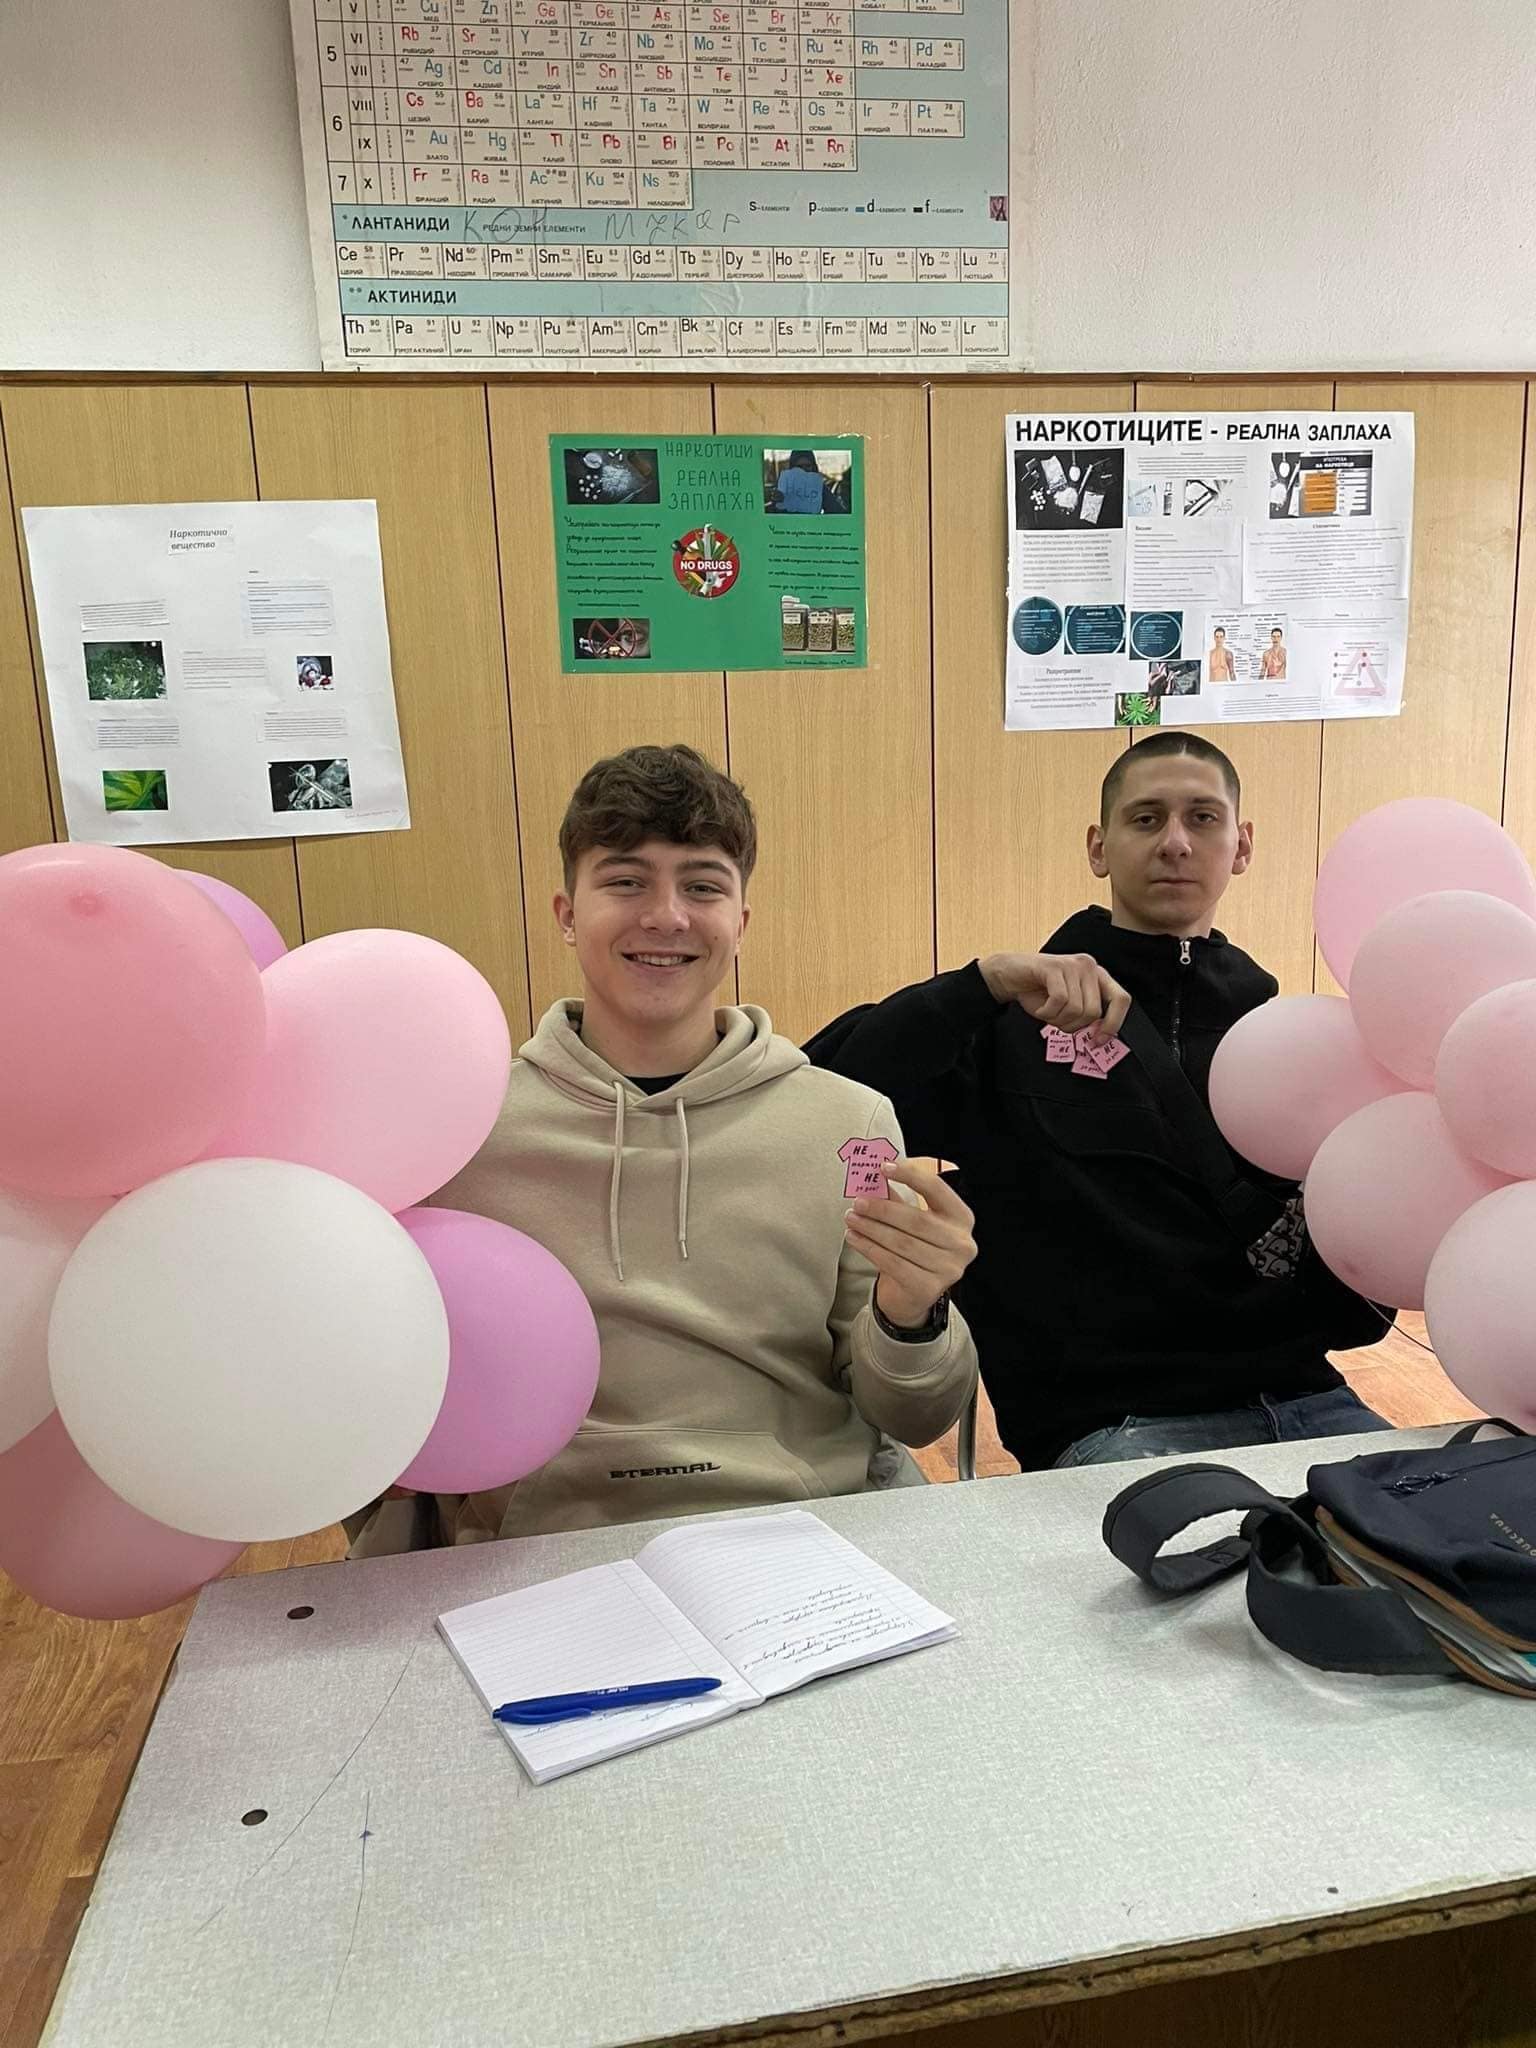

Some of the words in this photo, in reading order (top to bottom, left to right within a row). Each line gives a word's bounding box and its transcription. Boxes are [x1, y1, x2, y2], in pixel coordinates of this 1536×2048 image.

[350, 3, 357, 13] V
[482, 0, 498, 15] Zn
[538, 3, 556, 17] Ga
[596, 4, 614, 18] Ge
[654, 7, 671, 21] As
[713, 8, 729, 23] Se
[771, 10, 784, 24] Br
[826, 12, 841, 27] Kr
[351, 33, 362, 44] VI
[402, 26, 419, 41] Rb
[462, 28, 476, 42] Sr
[521, 30, 529, 44] Y
[580, 32, 593, 46] Zr
[637, 34, 654, 48] Nb
[695, 36, 714, 50] Mo
[752, 37, 766, 52] Tc
[807, 40, 823, 53] Ru
[862, 41, 878, 55] Rh
[327, 46, 336, 61] 5
[916, 42, 932, 56] Pd
[351, 65, 367, 76] VII
[424, 59, 442, 78] Ag
[484, 58, 502, 74] Cd
[547, 62, 559, 77] In
[599, 63, 616, 78] Sn
[657, 65, 672, 79] Sb
[717, 67, 731, 82] Te
[781, 68, 788, 82] J
[826, 69, 843, 84] Xe
[352, 100, 372, 111] VIII
[407, 92, 424, 106] Cs
[466, 91, 483, 108] Ba
[583, 96, 597, 111] Hf
[640, 98, 656, 112] Ta
[697, 99, 710, 113] W
[753, 101, 769, 115] Re
[809, 102, 825, 116] Os
[864, 103, 872, 117] Ir
[917, 104, 931, 118] Pt
[333, 116, 342, 131] 6
[358, 138, 371, 149] IX
[429, 130, 447, 144] Au
[489, 131, 506, 151] Hg
[551, 133, 562, 147] Tl
[603, 133, 621, 149] Pb
[663, 135, 677, 150] Bi
[717, 137, 733, 151] Po
[775, 139, 789, 152] At
[827, 139, 844, 153] Rn
[413, 168, 427, 182] Fr
[471, 169, 488, 184] Ra
[586, 172, 604, 186] Ku
[643, 173, 659, 187] Ns
[338, 175, 346, 191] 7
[364, 178, 372, 189] X
[352, 217, 449, 232] ЛАНТАНИДИ
[339, 247, 357, 261] Ce
[389, 247, 404, 261] Pr
[446, 248, 463, 262] Nd
[491, 249, 512, 263] Pm
[539, 249, 560, 263] Sm
[587, 250, 602, 264] Eu
[633, 250, 650, 264] Gd
[680, 251, 695, 265] Tb
[725, 251, 743, 270] Dy
[776, 252, 792, 265] Ho
[823, 252, 835, 266] Er
[868, 253, 882, 266] Tu
[920, 253, 934, 266] Yb
[963, 252, 977, 266] Lu
[368, 290, 456, 304] АКТИНИДИ
[347, 320, 364, 334] Th
[396, 320, 413, 334] Pa
[452, 320, 461, 334] U
[497, 321, 514, 338] Np
[544, 321, 560, 335] Pu
[592, 322, 613, 335] Am
[637, 322, 657, 335] Cm
[681, 319, 698, 333] Bk
[728, 322, 743, 335] Cf
[778, 322, 793, 335] Es
[825, 322, 843, 335] Fm
[870, 322, 887, 335] Md
[920, 322, 936, 335] No
[964, 322, 976, 334] Lr
[1016, 419, 1202, 445] НАРКОТИЦИТЕ
[1227, 423, 1300, 442] РЕАЛНА
[1308, 423, 1392, 442] ЗАПЛАХА
[665, 441, 753, 458] НАРКОТИЦИ
[677, 469, 740, 486] РЕАЛНА
[668, 492, 754, 511] ЗАПЛАХА
[170, 530, 228, 539] Наркотично
[171, 542, 215, 550] вещество
[680, 561, 695, 570] NO
[697, 561, 733, 570] DRUGS
[610, 1462, 721, 1479] ETERNAL
